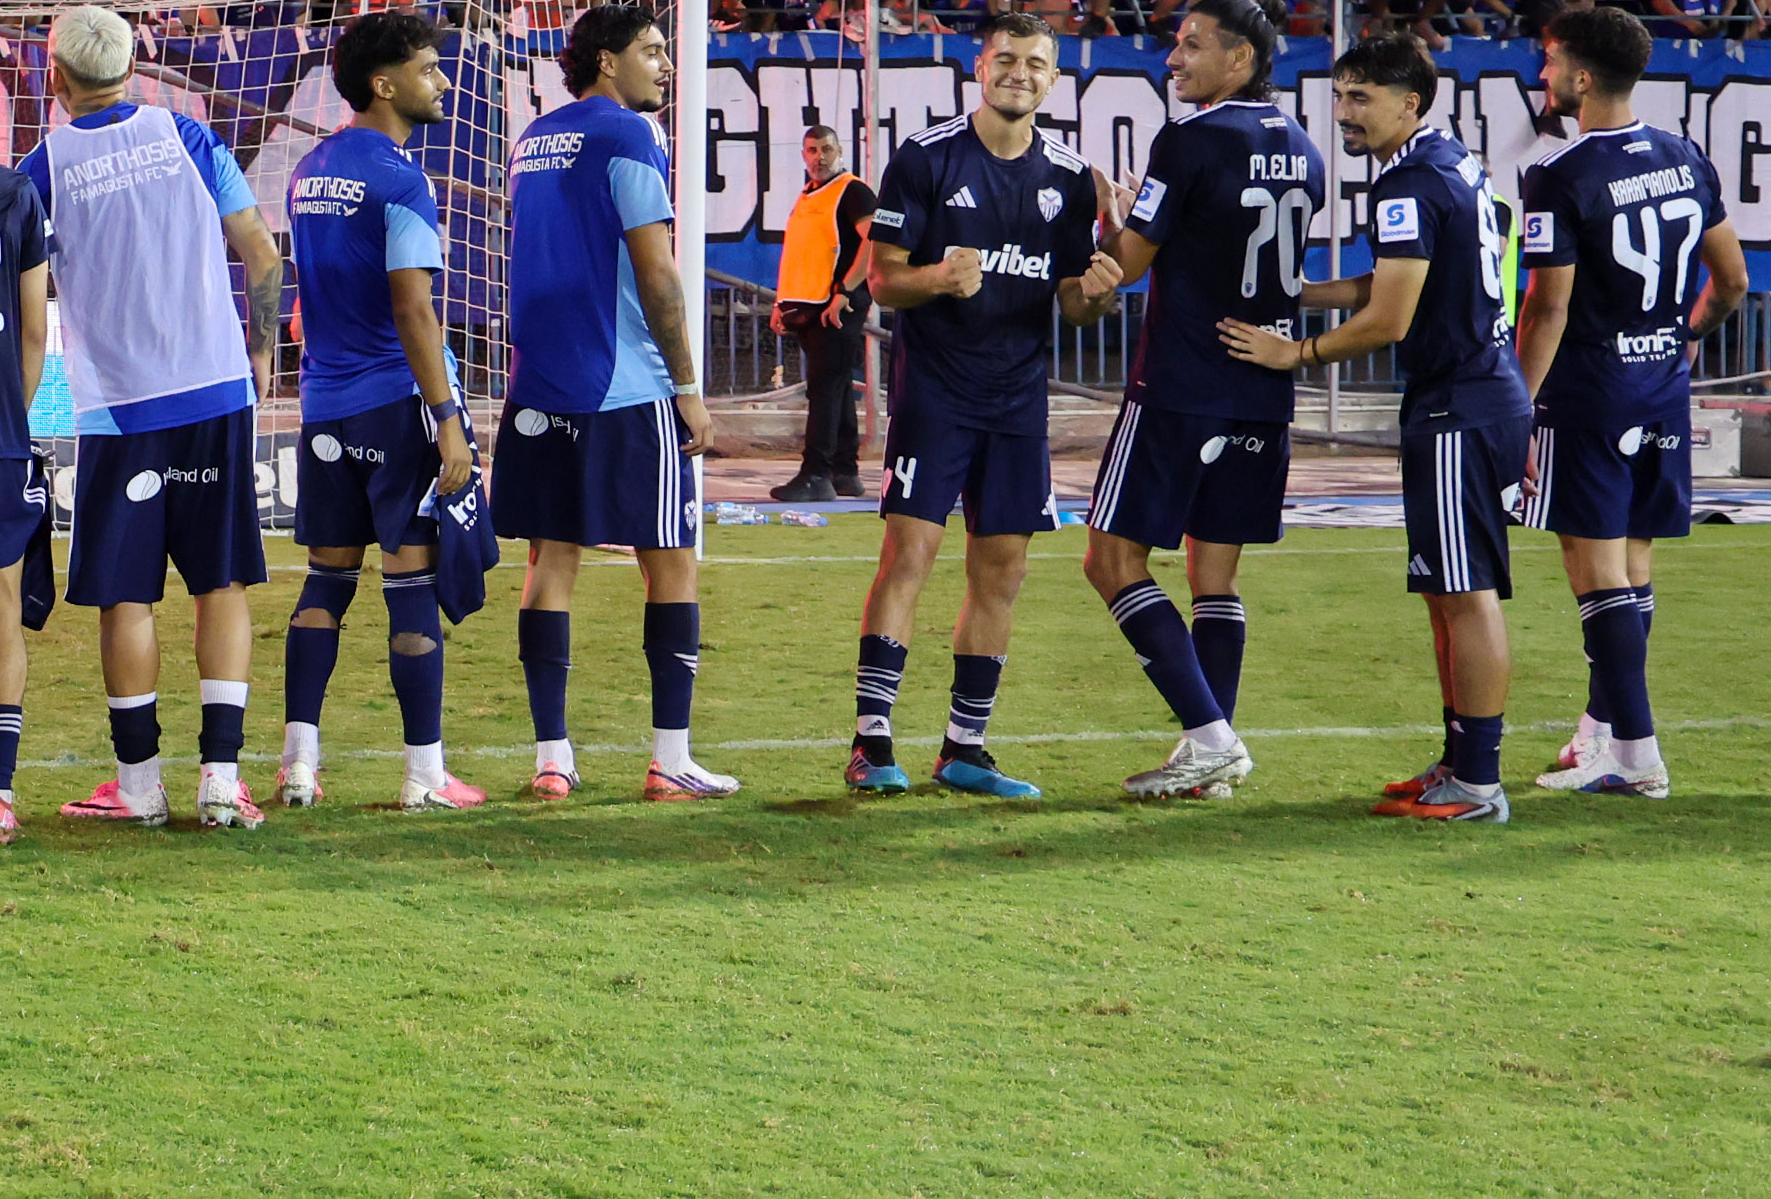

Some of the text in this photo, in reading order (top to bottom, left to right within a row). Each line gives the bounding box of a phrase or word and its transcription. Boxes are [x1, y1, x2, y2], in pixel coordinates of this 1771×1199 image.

[513, 132, 585, 158] ANORTHOSIS
[63, 138, 182, 191] ANORTHOSIS
[1249, 154, 1307, 181] M.ELIA
[70, 166, 162, 205] FAMAGUSTA FC
[292, 176, 366, 203] ANORTHOSIS
[1608, 165, 1695, 207] KARAMANOLIS
[292, 201, 332, 215] FAMAGUSTA
[1240, 186, 1313, 299] 70
[1613, 198, 1703, 311] 47
[944, 243, 1052, 281] vibet
[366, 447, 385, 464] Oil
[201, 467, 218, 483] Oil
[894, 456, 917, 499] 4
